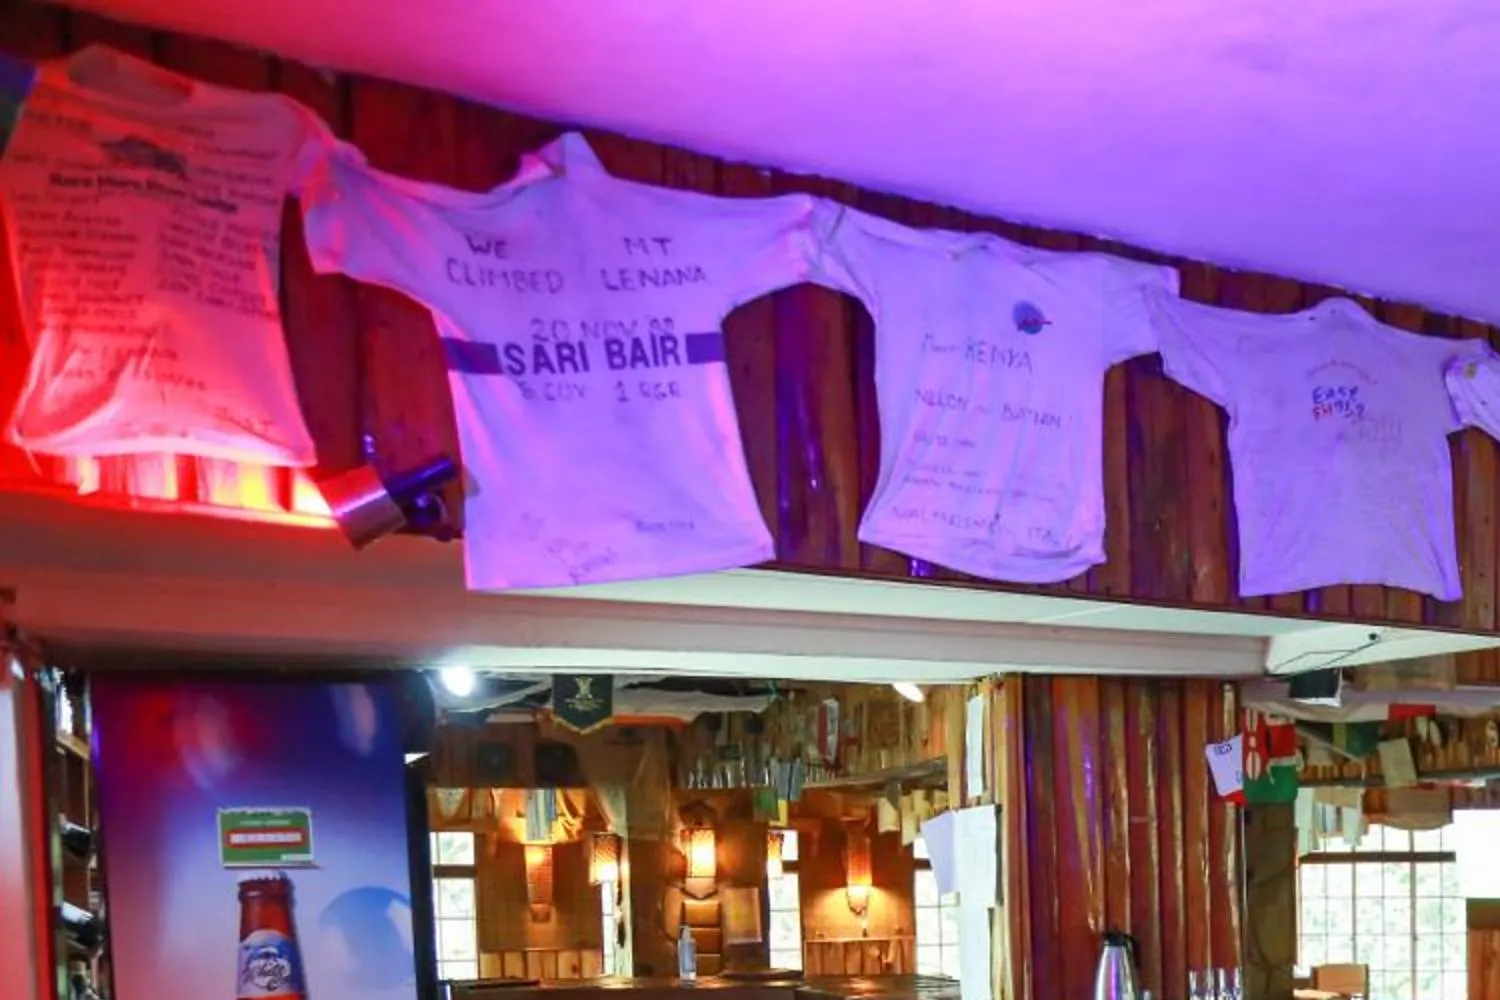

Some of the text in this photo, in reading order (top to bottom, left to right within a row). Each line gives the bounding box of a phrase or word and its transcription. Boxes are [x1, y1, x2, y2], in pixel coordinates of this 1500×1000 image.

[464, 233, 510, 260] WE
[445, 257, 564, 294] CLIMBED
[600, 266, 708, 292] LENANA
[502, 332, 682, 376] SARI BAIR
